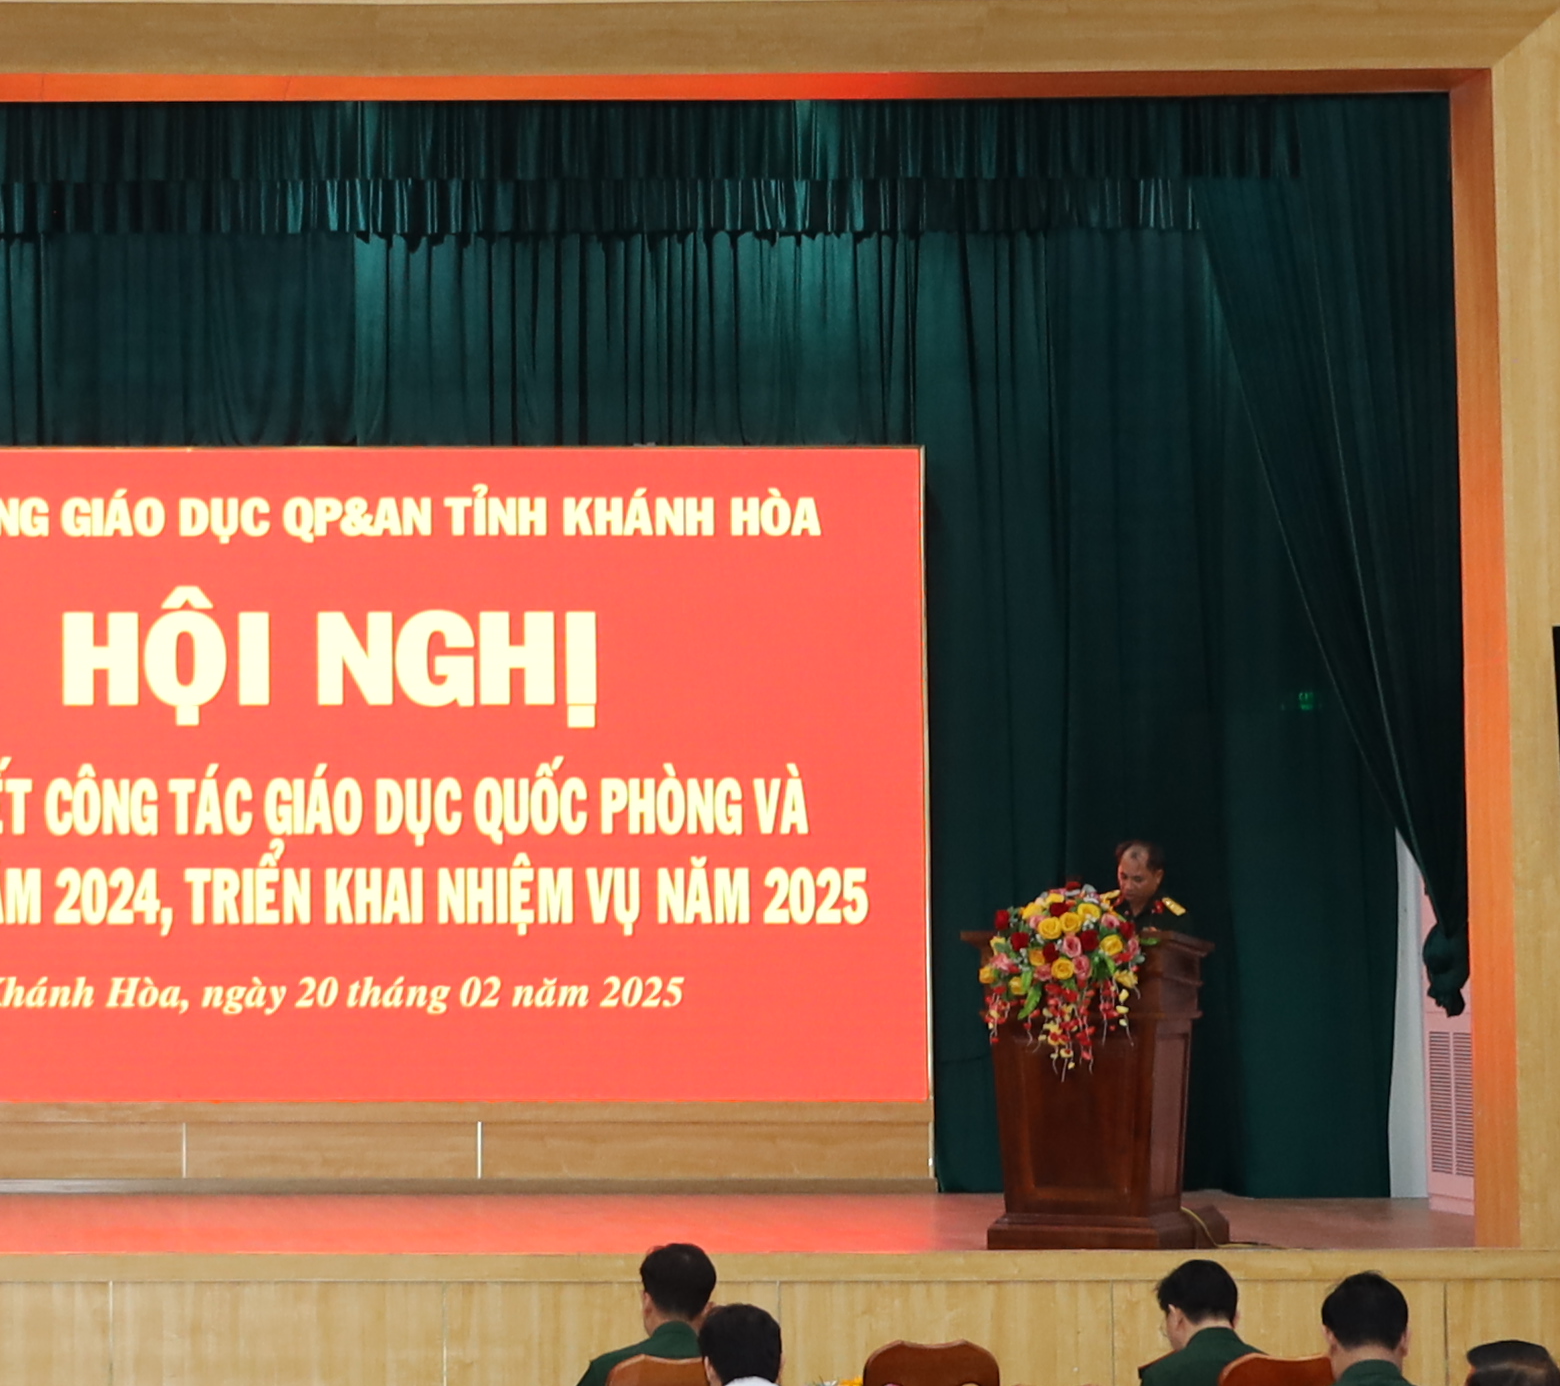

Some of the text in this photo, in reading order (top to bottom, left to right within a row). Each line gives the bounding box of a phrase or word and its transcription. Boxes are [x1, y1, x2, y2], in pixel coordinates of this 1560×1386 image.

[60, 488, 165, 537] GIÁO
[179, 497, 270, 544] DỤC
[283, 497, 431, 543] QP&AN
[444, 484, 547, 536] TỈNH
[563, 488, 714, 536] KHÁNH
[731, 488, 821, 536] HÒA
[62, 586, 597, 728] HỘI NGHỊ
[44, 763, 158, 836] CÔNG
[168, 763, 252, 835] TÁC
[264, 763, 362, 835] GIÁO
[376, 777, 462, 846] DỤC
[474, 756, 587, 845] QUỐC
[601, 763, 742, 835] PHÒNG
[753, 763, 808, 834] VÀ
[54, 867, 173, 936] 2024,
[184, 838, 311, 925] TRIỂN
[325, 868, 423, 924] KHAI
[438, 852, 573, 936] NHIỆM
[585, 867, 639, 936] VỤ
[657, 856, 749, 924] NĂM
[763, 867, 868, 924] 2025
[106, 977, 189, 1014] Hòa,
[202, 977, 286, 1015] ngày
[295, 977, 338, 1008] 20
[347, 976, 450, 1014] tháng
[460, 976, 501, 1007] 02
[512, 978, 588, 1007] năm
[600, 976, 684, 1007] 2025
